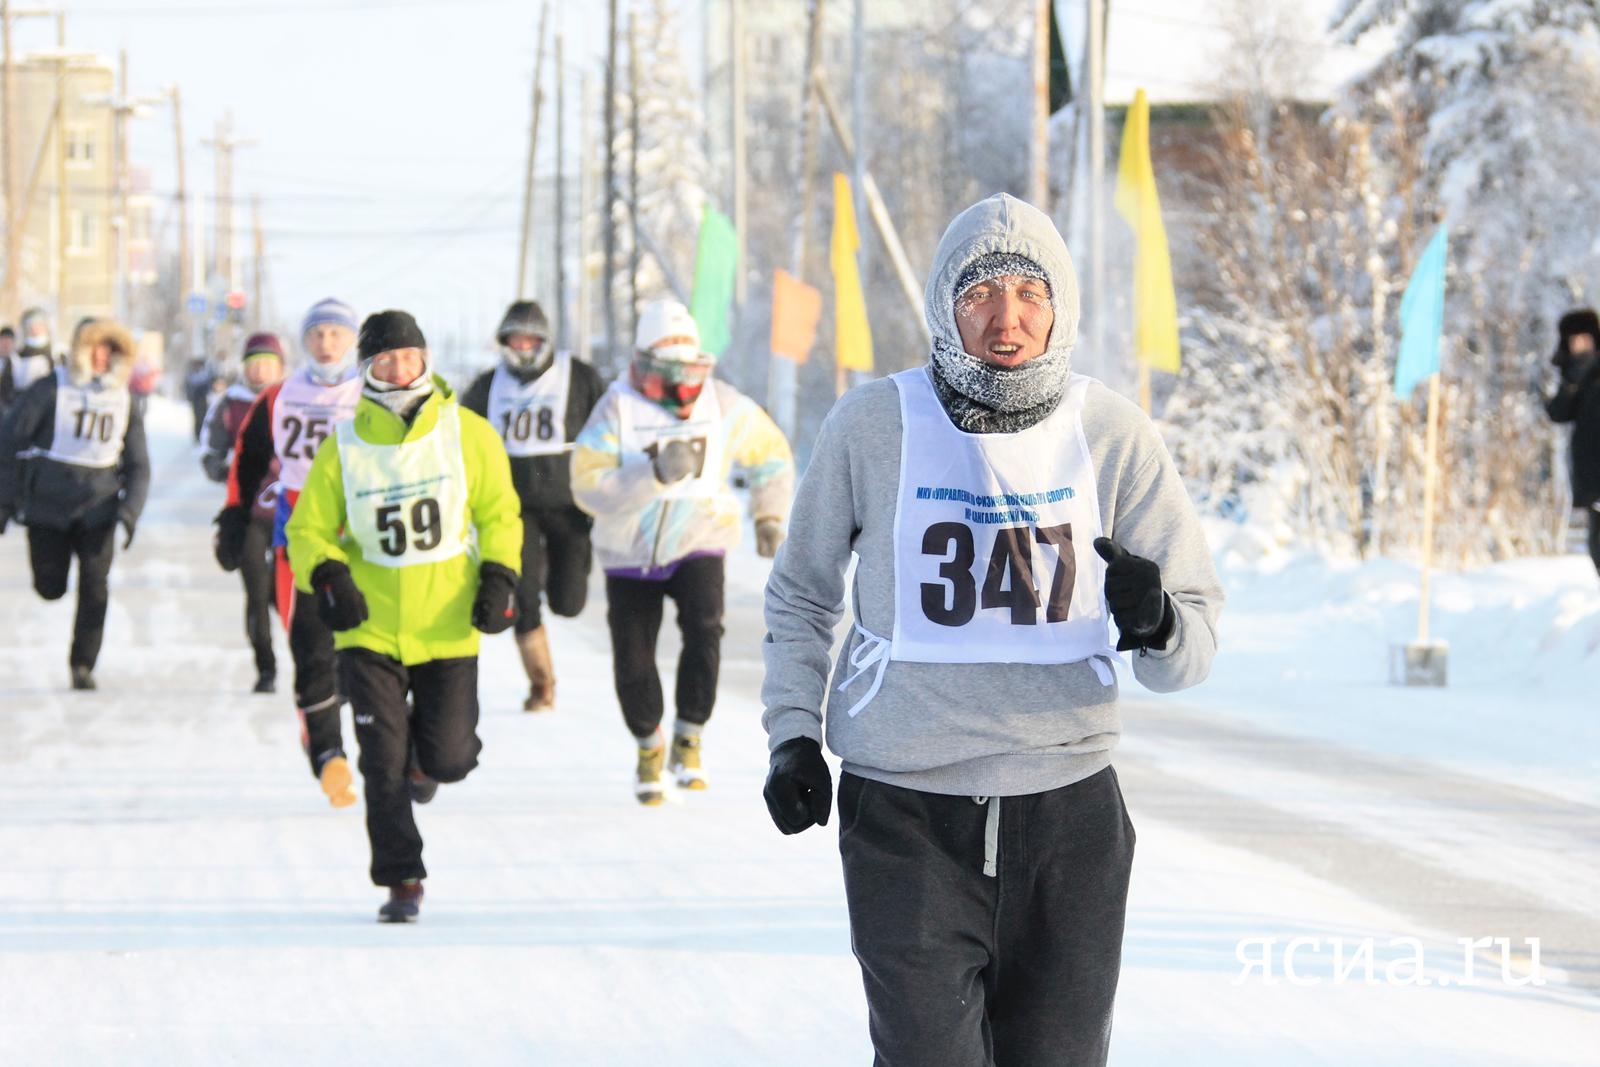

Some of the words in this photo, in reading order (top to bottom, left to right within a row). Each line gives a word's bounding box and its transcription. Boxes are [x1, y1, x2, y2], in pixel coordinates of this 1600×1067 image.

[73, 410, 114, 443] 170
[281, 415, 336, 461] 25
[501, 407, 554, 443] 108
[916, 486, 932, 500] МКУ
[375, 498, 442, 557] 59
[920, 521, 1076, 627] 347
